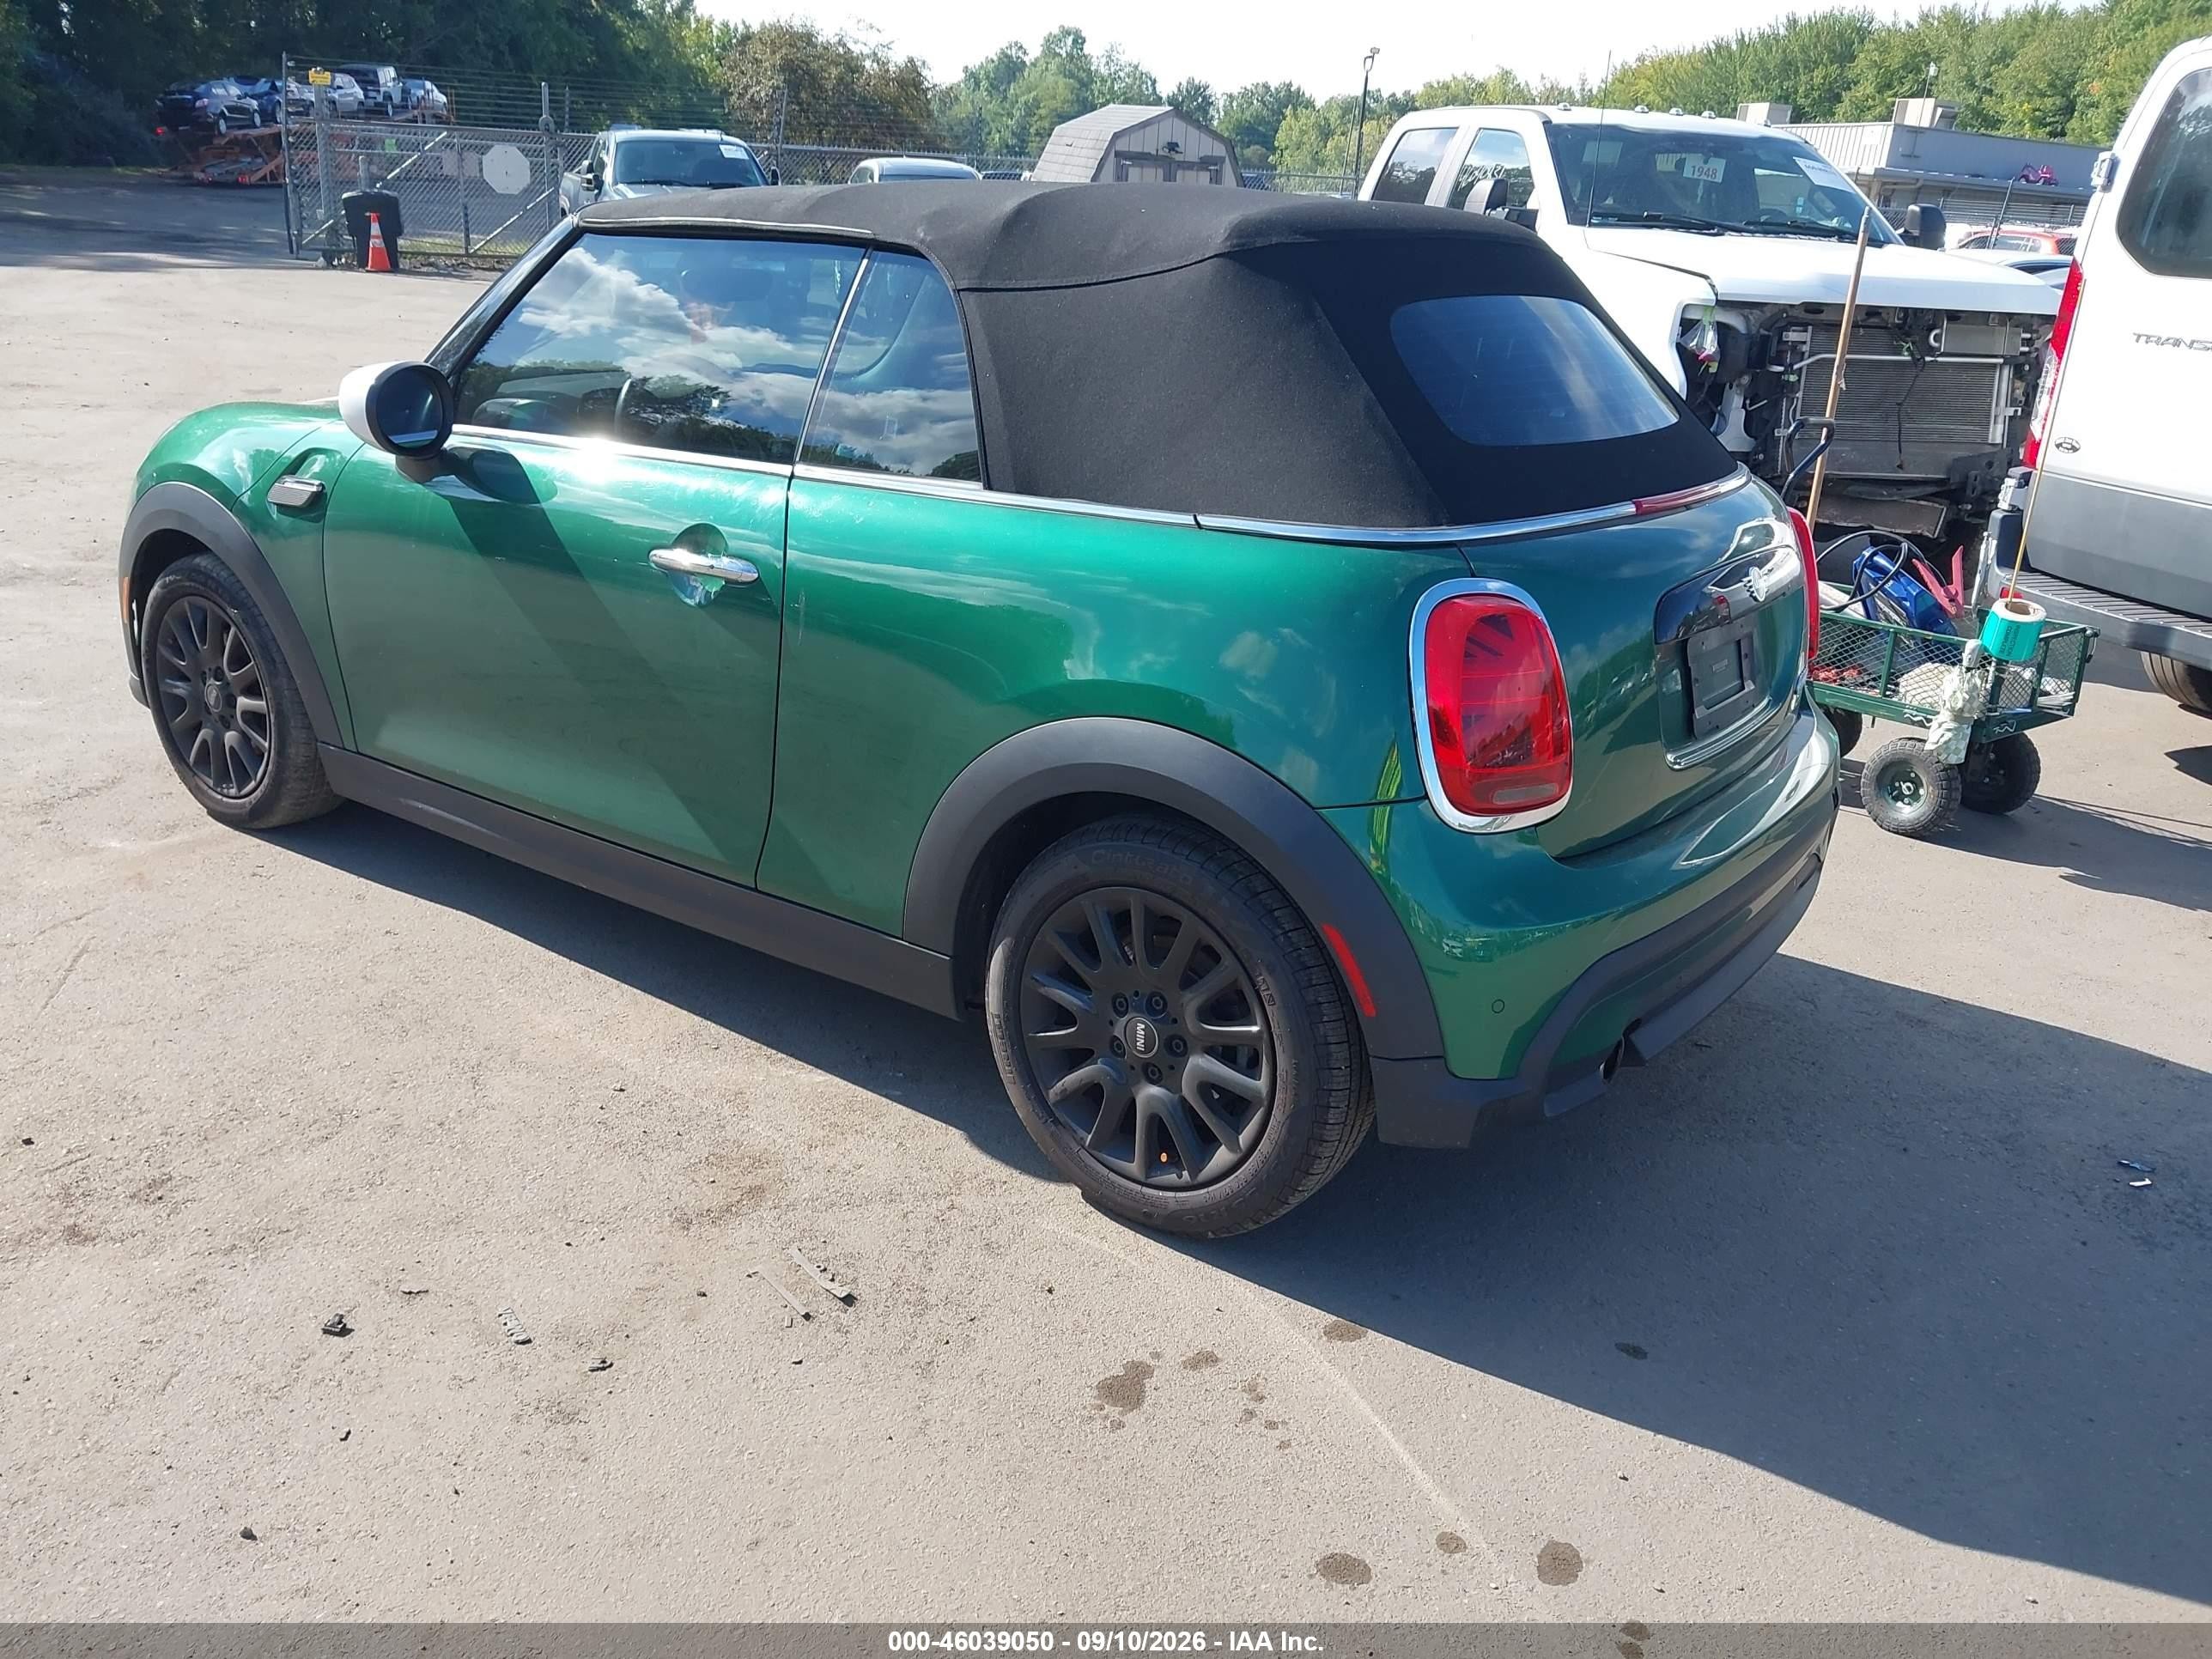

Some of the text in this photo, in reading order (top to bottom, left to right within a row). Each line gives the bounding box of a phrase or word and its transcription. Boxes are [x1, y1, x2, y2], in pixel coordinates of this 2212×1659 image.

[1692, 165, 1717, 179] 1948
[2132, 332, 2212, 351] TRANS
[1136, 1023, 1146, 1051] MINI
